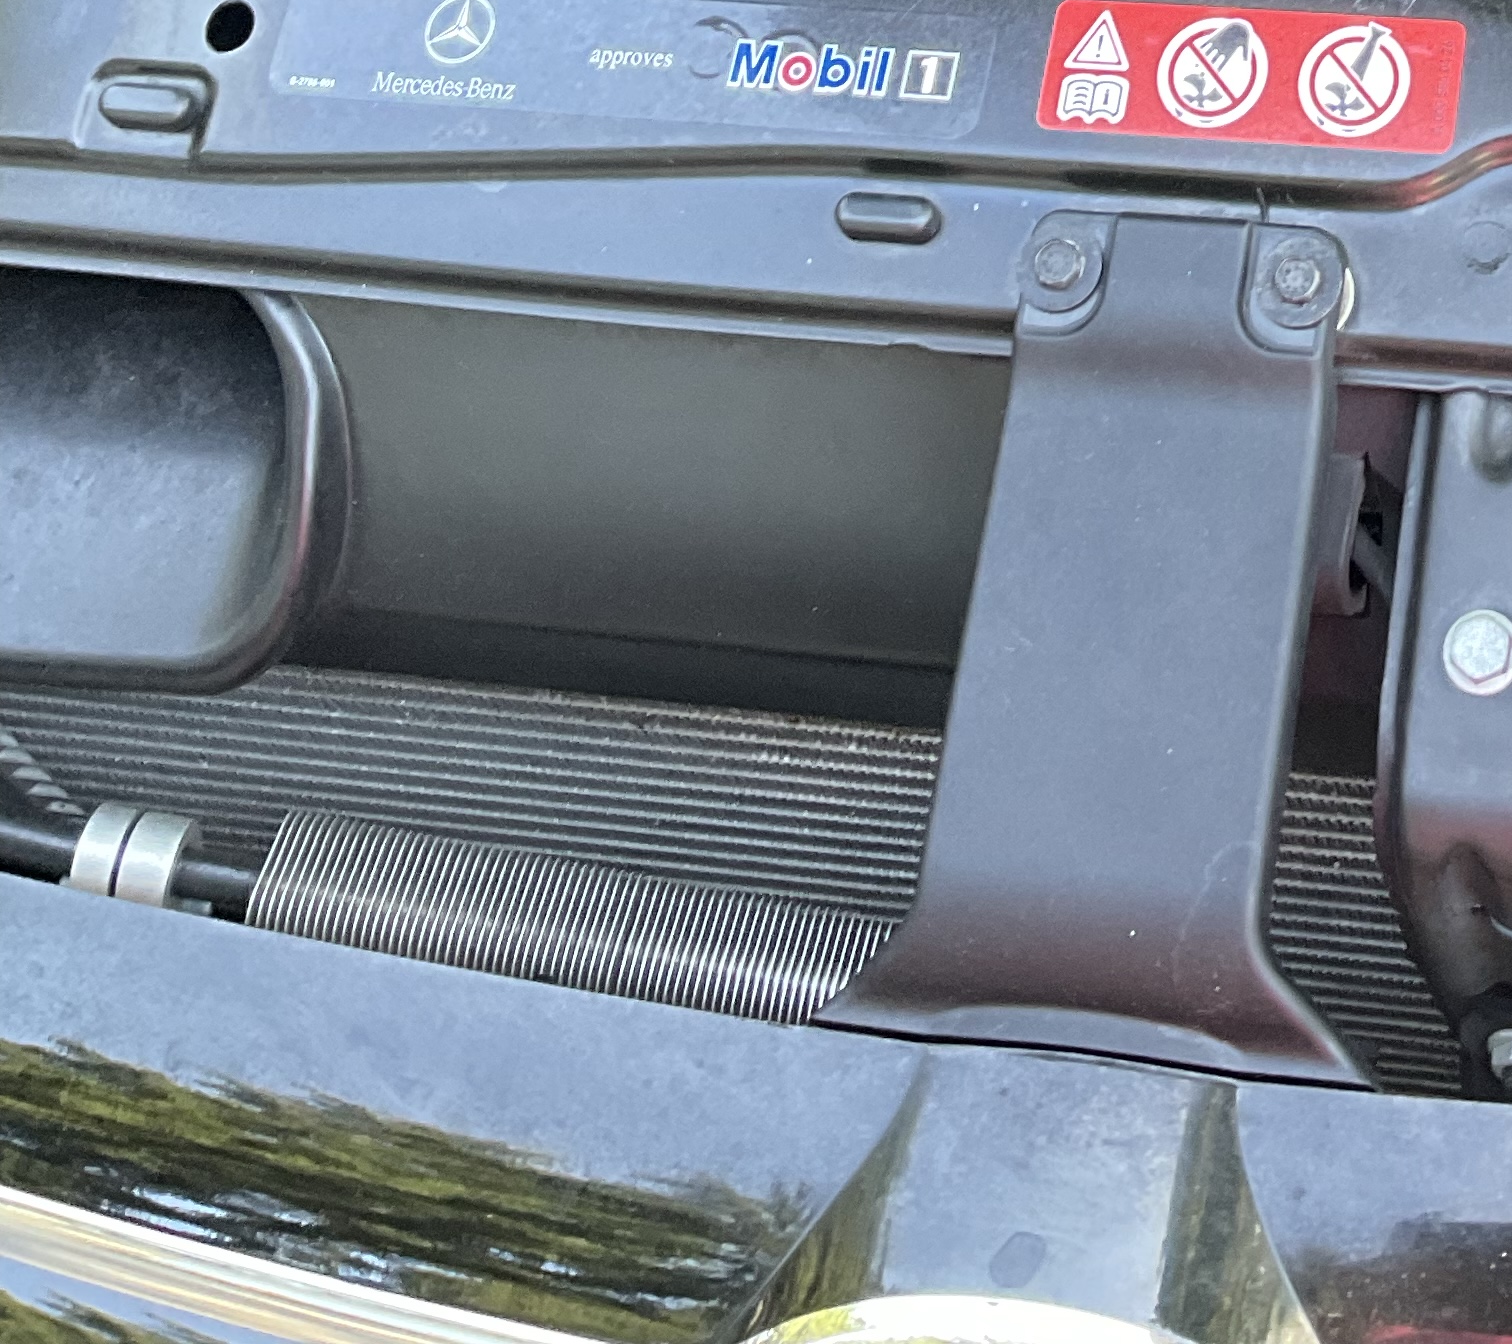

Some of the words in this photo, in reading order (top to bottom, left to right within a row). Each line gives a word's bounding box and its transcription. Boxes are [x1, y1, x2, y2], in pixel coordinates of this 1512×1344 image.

[371, 71, 516, 100] Mercedes-Benz
[589, 46, 674, 70] approves
[727, 38, 895, 97] Mobil
